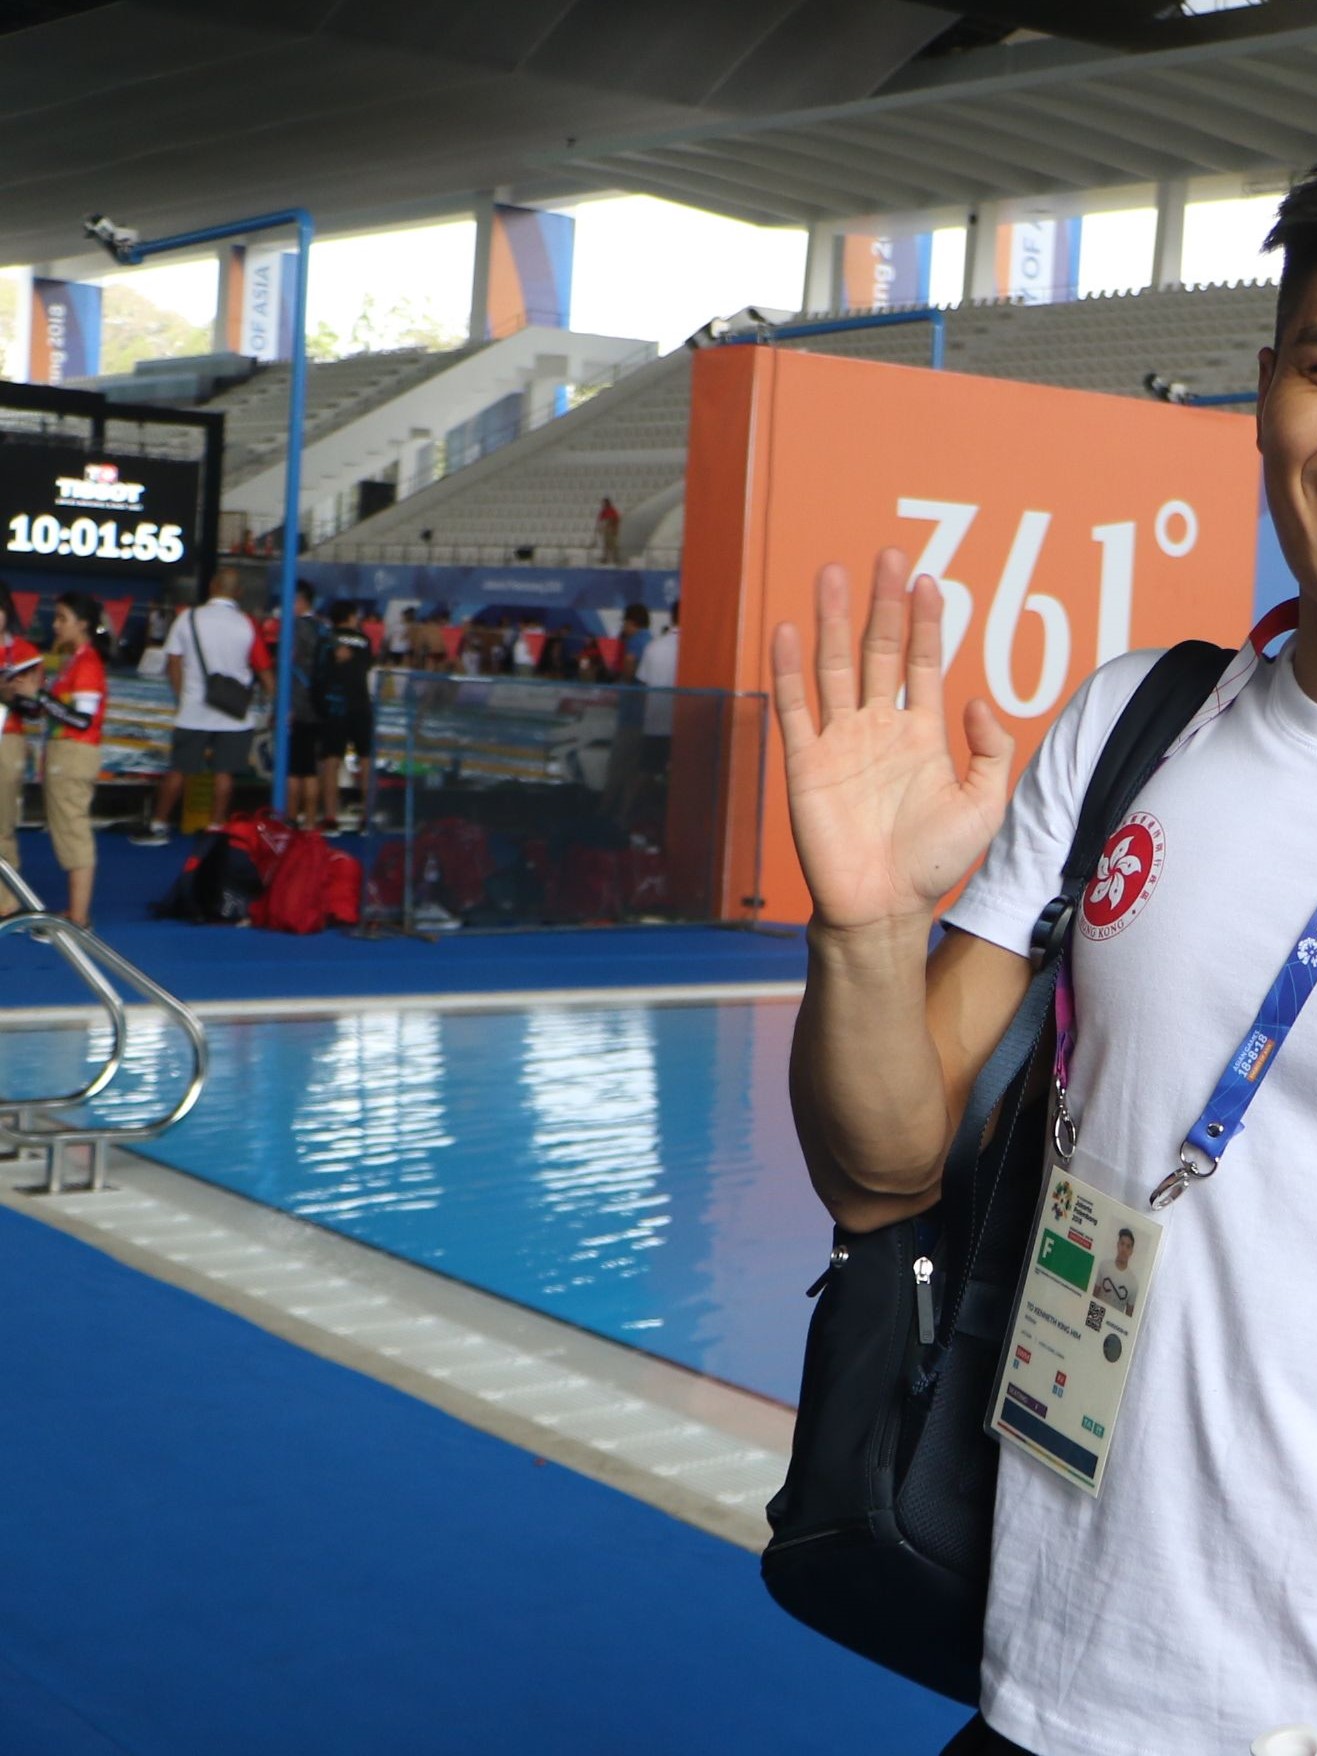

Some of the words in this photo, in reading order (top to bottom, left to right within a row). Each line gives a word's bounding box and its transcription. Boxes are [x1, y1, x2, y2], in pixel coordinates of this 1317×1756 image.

[254, 264, 271, 315] ASIA
[48, 303, 67, 347] 2018
[251, 319, 270, 351] OF
[7, 513, 184, 563] 10:01:55
[1098, 918, 1125, 938] KONG
[1232, 1051, 1248, 1072] ASIAN
[1042, 1237, 1055, 1258] F
